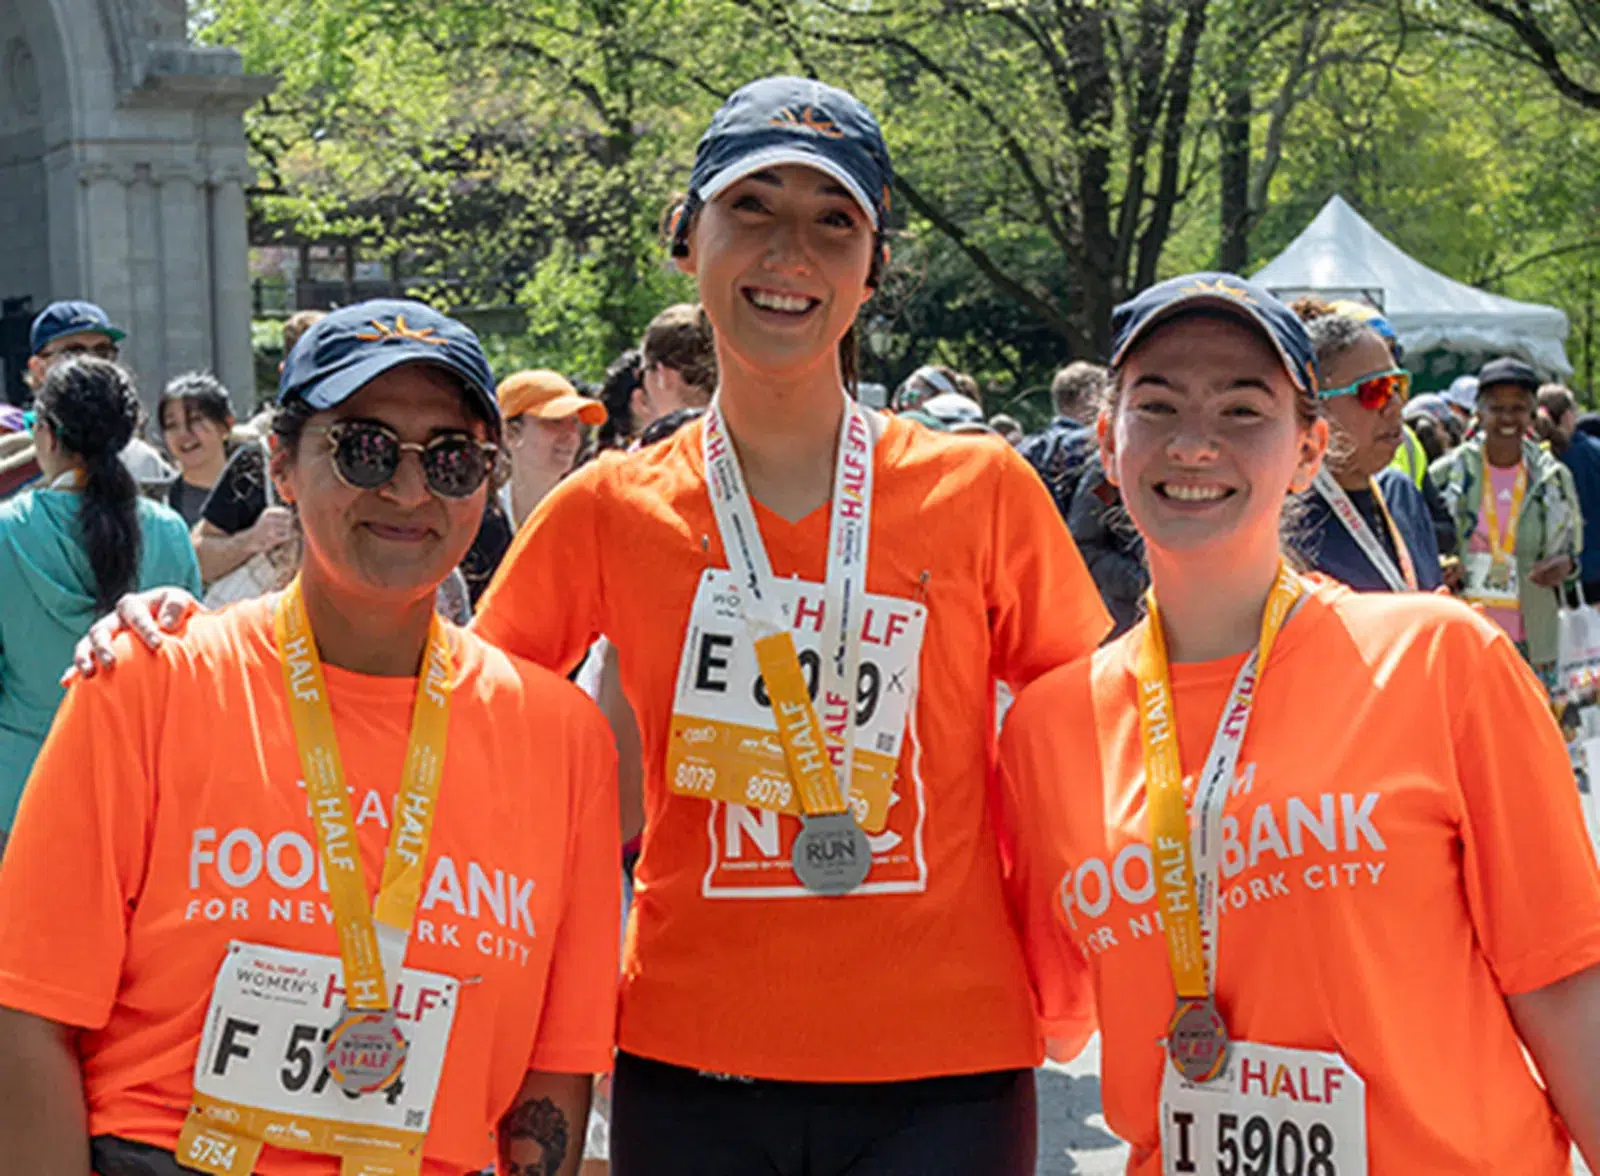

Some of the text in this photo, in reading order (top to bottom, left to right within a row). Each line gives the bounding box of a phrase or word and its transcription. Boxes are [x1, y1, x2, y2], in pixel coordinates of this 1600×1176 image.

[840, 454, 866, 519] HALF
[793, 597, 909, 646] HLF
[284, 637, 319, 703] HALF
[424, 641, 449, 708] HALF
[696, 633, 733, 692] E
[754, 649, 880, 727] 09
[780, 701, 823, 774] HALF
[824, 691, 848, 766] HALF
[1143, 679, 1168, 744] HALF
[676, 763, 717, 792] 8079
[746, 775, 793, 807] 8079
[317, 797, 354, 872] HALF
[396, 791, 430, 867] HALF
[806, 840, 857, 861] RUN
[1061, 843, 1157, 931] FOO
[1219, 793, 1387, 880] BANK
[1158, 836, 1191, 913] HALF
[1303, 862, 1387, 890] CITY
[421, 856, 536, 936] ANK
[185, 897, 249, 921] FOR
[417, 920, 460, 948] RK
[476, 931, 533, 967] CITY
[236, 968, 319, 994] WOMEN'S
[322, 973, 440, 1021] HLF
[212, 1017, 259, 1076] F
[339, 1050, 390, 1068] HALF
[1240, 1058, 1345, 1104] HALF
[189, 1135, 237, 1171] 5754
[1217, 1113, 1336, 1176] 5908
